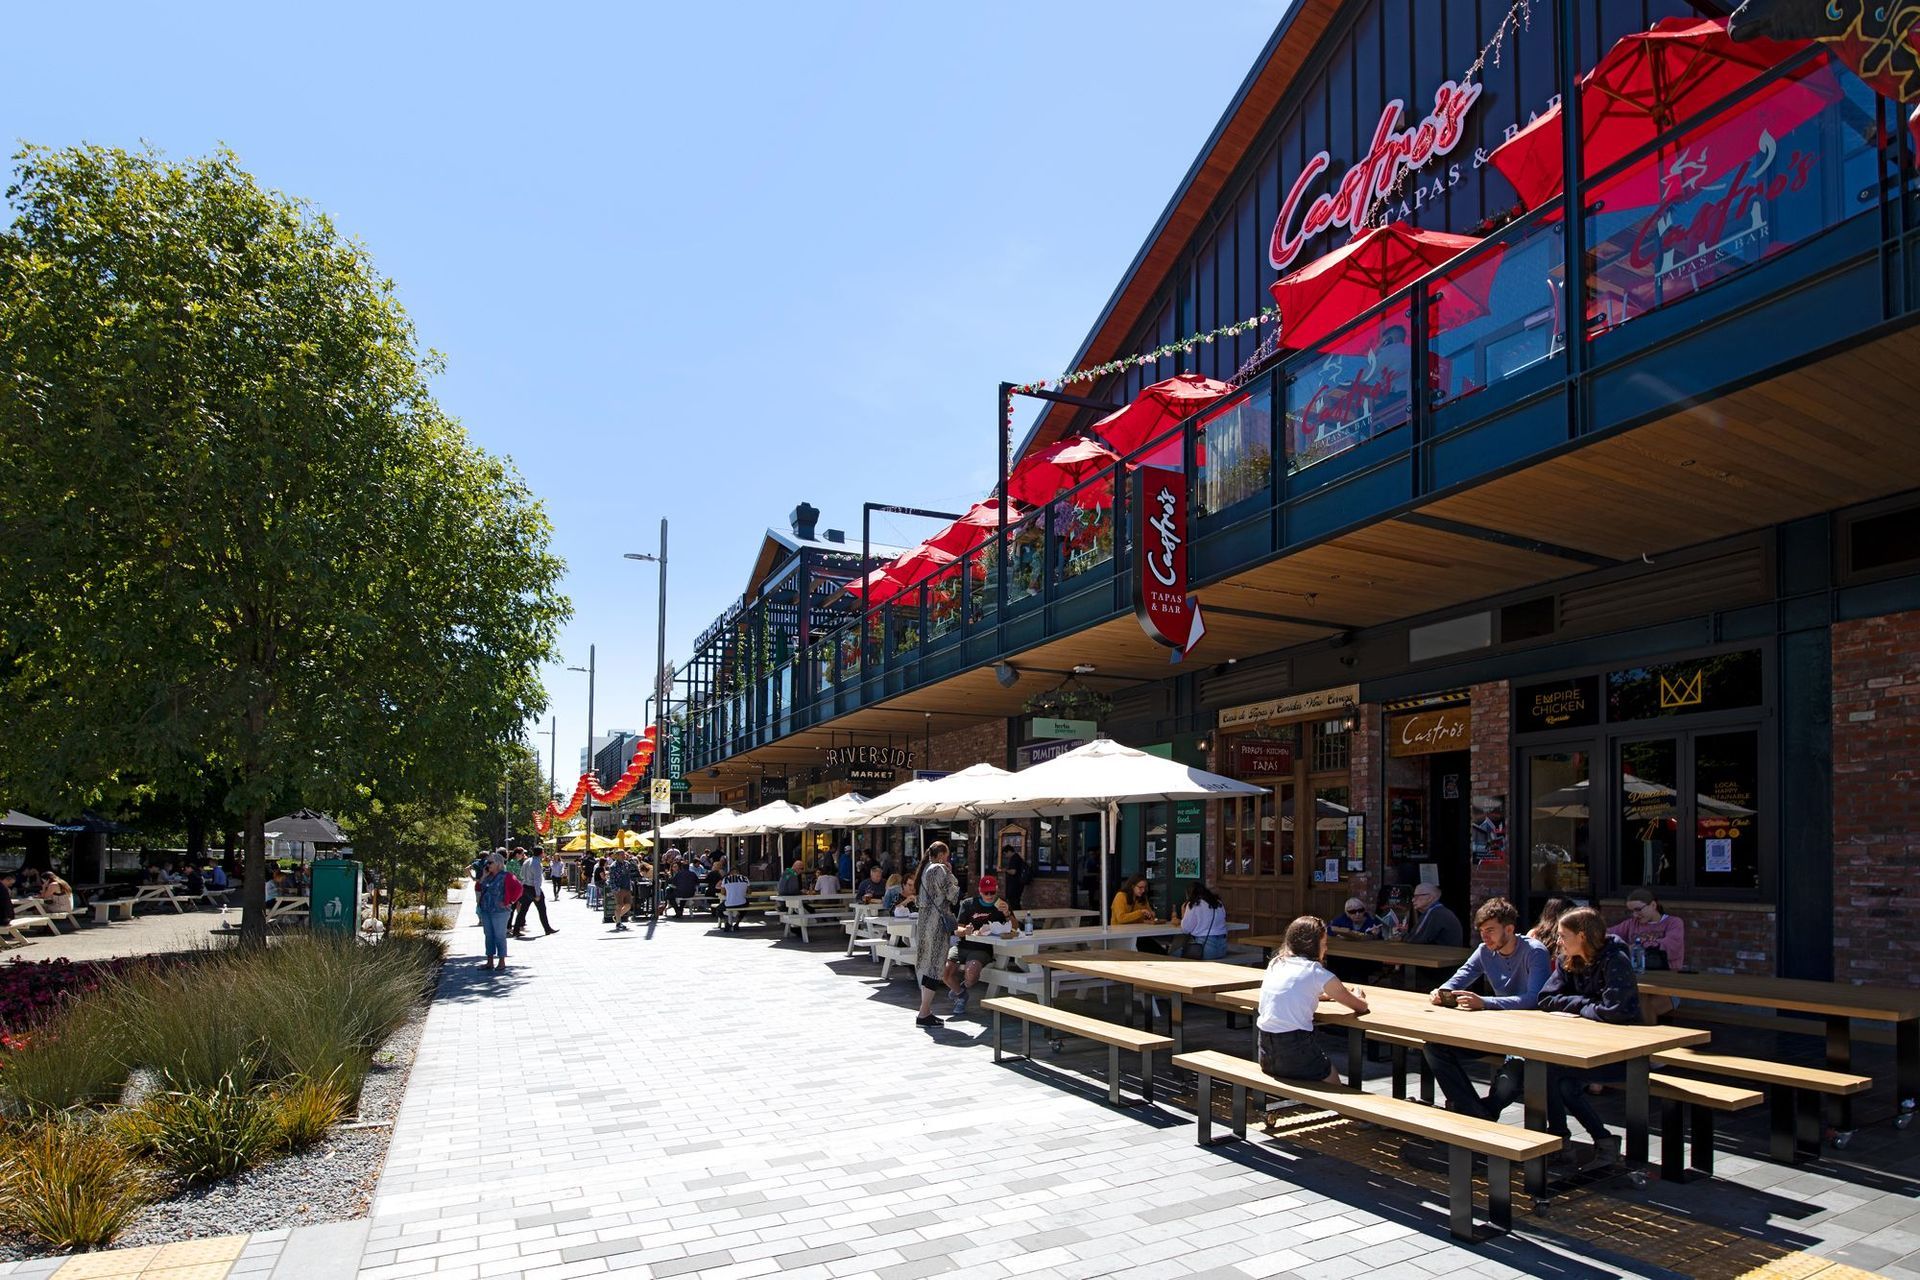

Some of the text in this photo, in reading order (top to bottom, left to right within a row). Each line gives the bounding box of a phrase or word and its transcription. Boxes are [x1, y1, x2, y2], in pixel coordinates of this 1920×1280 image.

[1269, 80, 1482, 270] Castro's
[1379, 163, 1460, 227] TAPAS
[1472, 147, 1491, 169] &
[1656, 255, 1708, 287] TAPAS
[1735, 225, 1769, 250] BAR
[1147, 486, 1183, 587] Castro's
[1151, 591, 1182, 604] TAPAS
[1151, 603, 1181, 614] & BAR
[1532, 699, 1585, 716] CHICKEN
[1402, 716, 1465, 745] Castro's
[670, 736, 680, 780] KAISER
[829, 746, 916, 769] RIVERSIDE
[1252, 760, 1278, 771] TAPAS
[851, 771, 893, 779] MARKET
